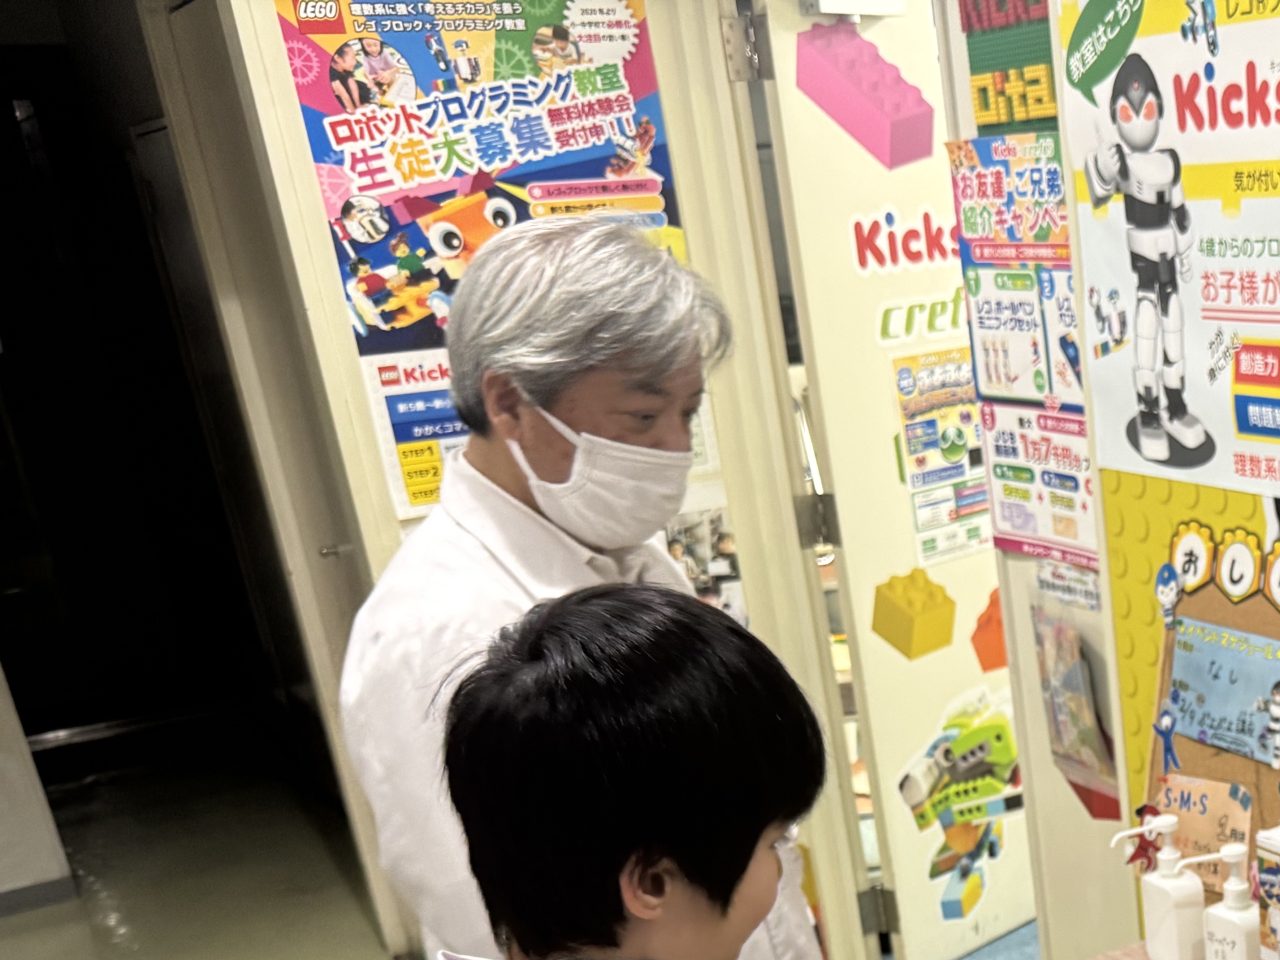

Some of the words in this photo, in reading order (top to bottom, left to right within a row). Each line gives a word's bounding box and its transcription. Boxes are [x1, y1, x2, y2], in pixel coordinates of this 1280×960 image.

[298, 0, 338, 19] LEGO
[329, 63, 626, 147] ロボットプログラミング教室
[971, 64, 1057, 126] Oita
[348, 114, 554, 192] 生徒大募集
[962, 206, 1069, 235] 紹介キャンペー
[403, 364, 452, 385] Kick
[1239, 352, 1279, 377] 創造力
